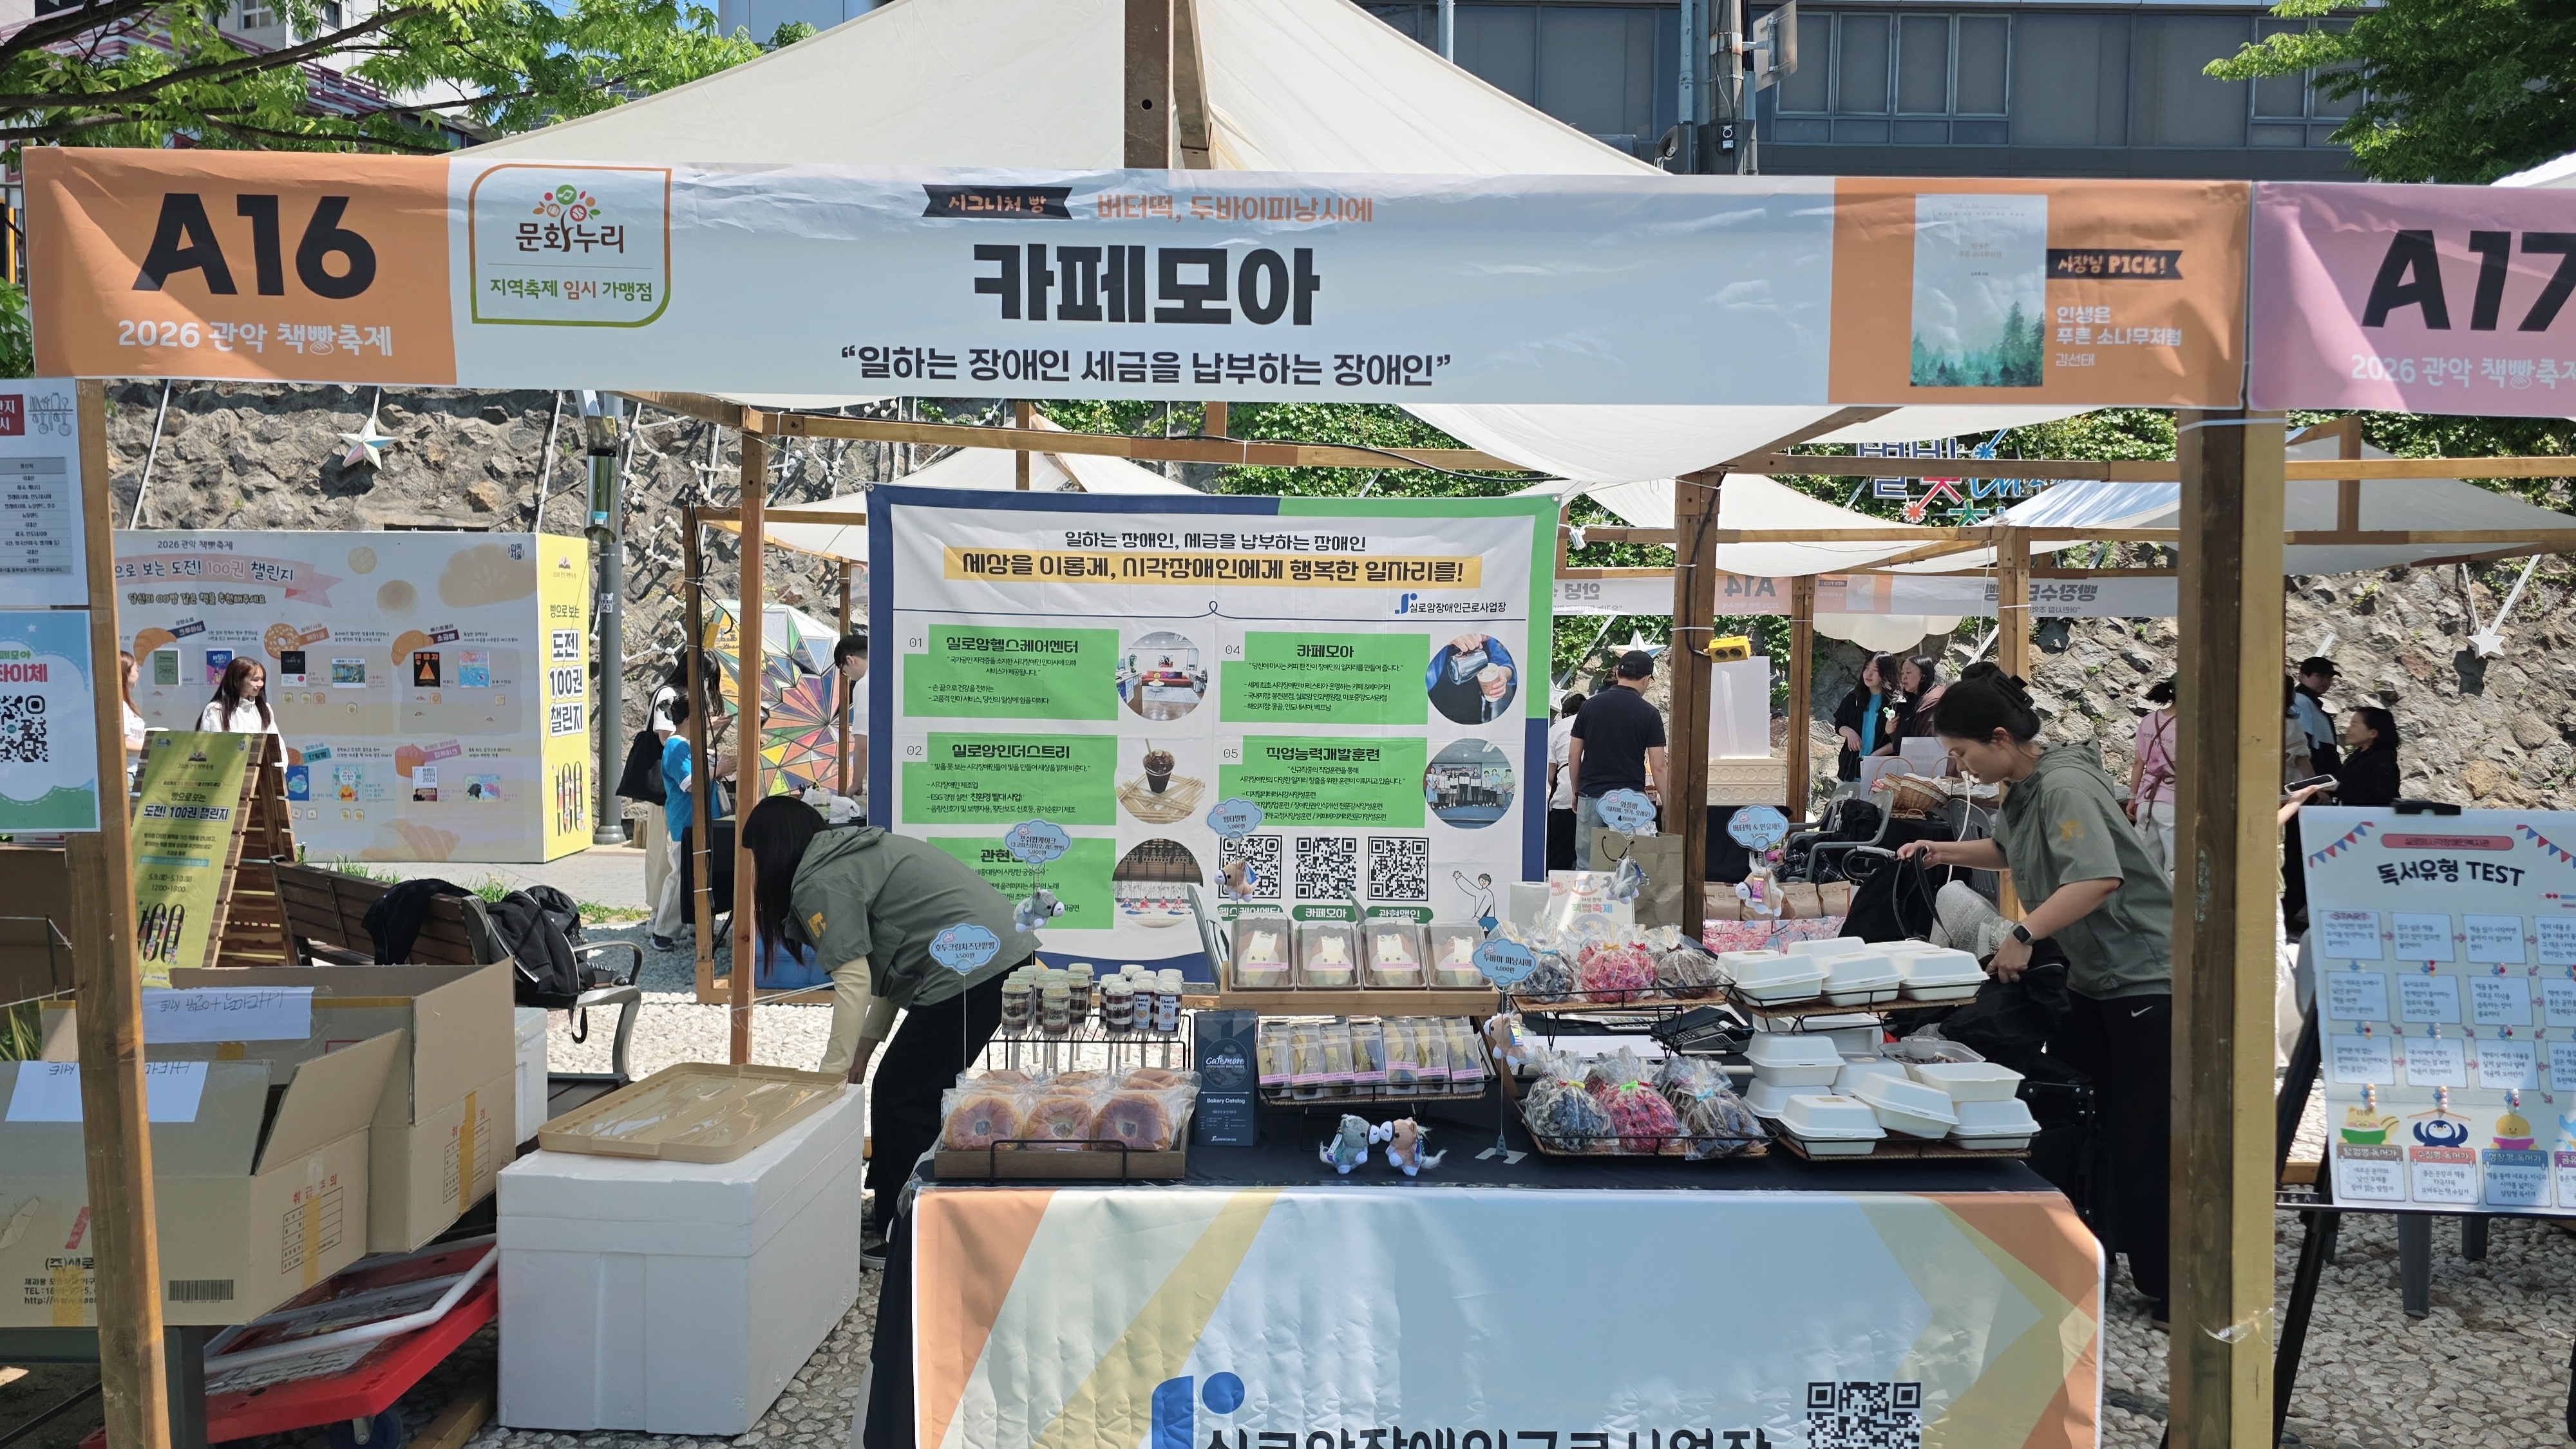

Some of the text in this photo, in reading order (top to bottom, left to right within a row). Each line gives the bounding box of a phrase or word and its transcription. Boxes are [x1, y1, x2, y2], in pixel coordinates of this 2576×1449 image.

[949, 194, 1047, 213] 시그니처 빵
[1097, 194, 1373, 223] 버터떡, 두바이피낭시에
[516, 222, 624, 254] 문화누리
[132, 193, 377, 299] A16
[2058, 255, 2166, 274] 사장님 PICK!
[974, 244, 1320, 325] 카페모아
[2362, 229, 2576, 332] A17
[490, 279, 653, 303] 지역축제 임시 가맹점
[2057, 307, 2111, 323] 인생은
[118, 320, 392, 356] 2026 관악 책빵축제
[2056, 327, 2182, 346] 푸른 소나무처럼
[842, 345, 1451, 387] “일하는 장애인 세금을 납부하는 장애인”
[2056, 354, 2095, 367] 김선태
[2351, 355, 2416, 383] 2026
[2422, 357, 2473, 388] 관악
[181, 540, 196, 549] 관악
[1065, 531, 1366, 553] 일하는 장애인, 세금을 납부하는 장애인
[143, 561, 165, 576] 보는
[172, 560, 201, 574] 도전!
[207, 561, 245, 578] 100권
[251, 561, 294, 581] 챌린지
[963, 552, 1463, 583] 세상을 이롭게, 시각장애인에게 행복한 일자리를!
[128, 592, 154, 604] 당신의
[181, 592, 197, 604] 같은
[199, 592, 216, 604] 책을
[218, 592, 265, 604] 추천해주세요
[550, 605, 580, 618] 빵으로 보는
[1409, 601, 1506, 614] 실로암장애인근로사업장
[553, 633, 578, 658] 도전!
[909, 638, 922, 647] 01
[947, 637, 1078, 653] 실로암헬스케어센터
[1226, 645, 1240, 654] 04
[1297, 645, 1354, 658] 카페모아
[549, 668, 583, 696] 100권
[551, 705, 583, 734] 챌린지
[907, 746, 922, 755] 02
[952, 744, 1070, 759] 실로암인더스트리
[1224, 749, 1238, 758] 05
[1266, 747, 1380, 762] 직업능력개발훈련
[171, 792, 206, 802] 빵으로 보는
[144, 806, 229, 820] 도전! 100권 챌린지
[1620, 801, 1638, 810] 와플바
[1760, 822, 1783, 831] 연유세트
[2377, 858, 2525, 887] 독서유형 TEST
[1305, 908, 1347, 918] 카페모아
[1572, 904, 1612, 913] 책빵축제
[2333, 912, 2367, 920] START
[935, 941, 996, 952] 호두크림치즈단팥빵
[1484, 954, 1532, 967] 두바이 피낭시에
[2417, 1150, 2469, 1160] 수집형 독서가
[2489, 1153, 2541, 1162] 성장형 독서가
